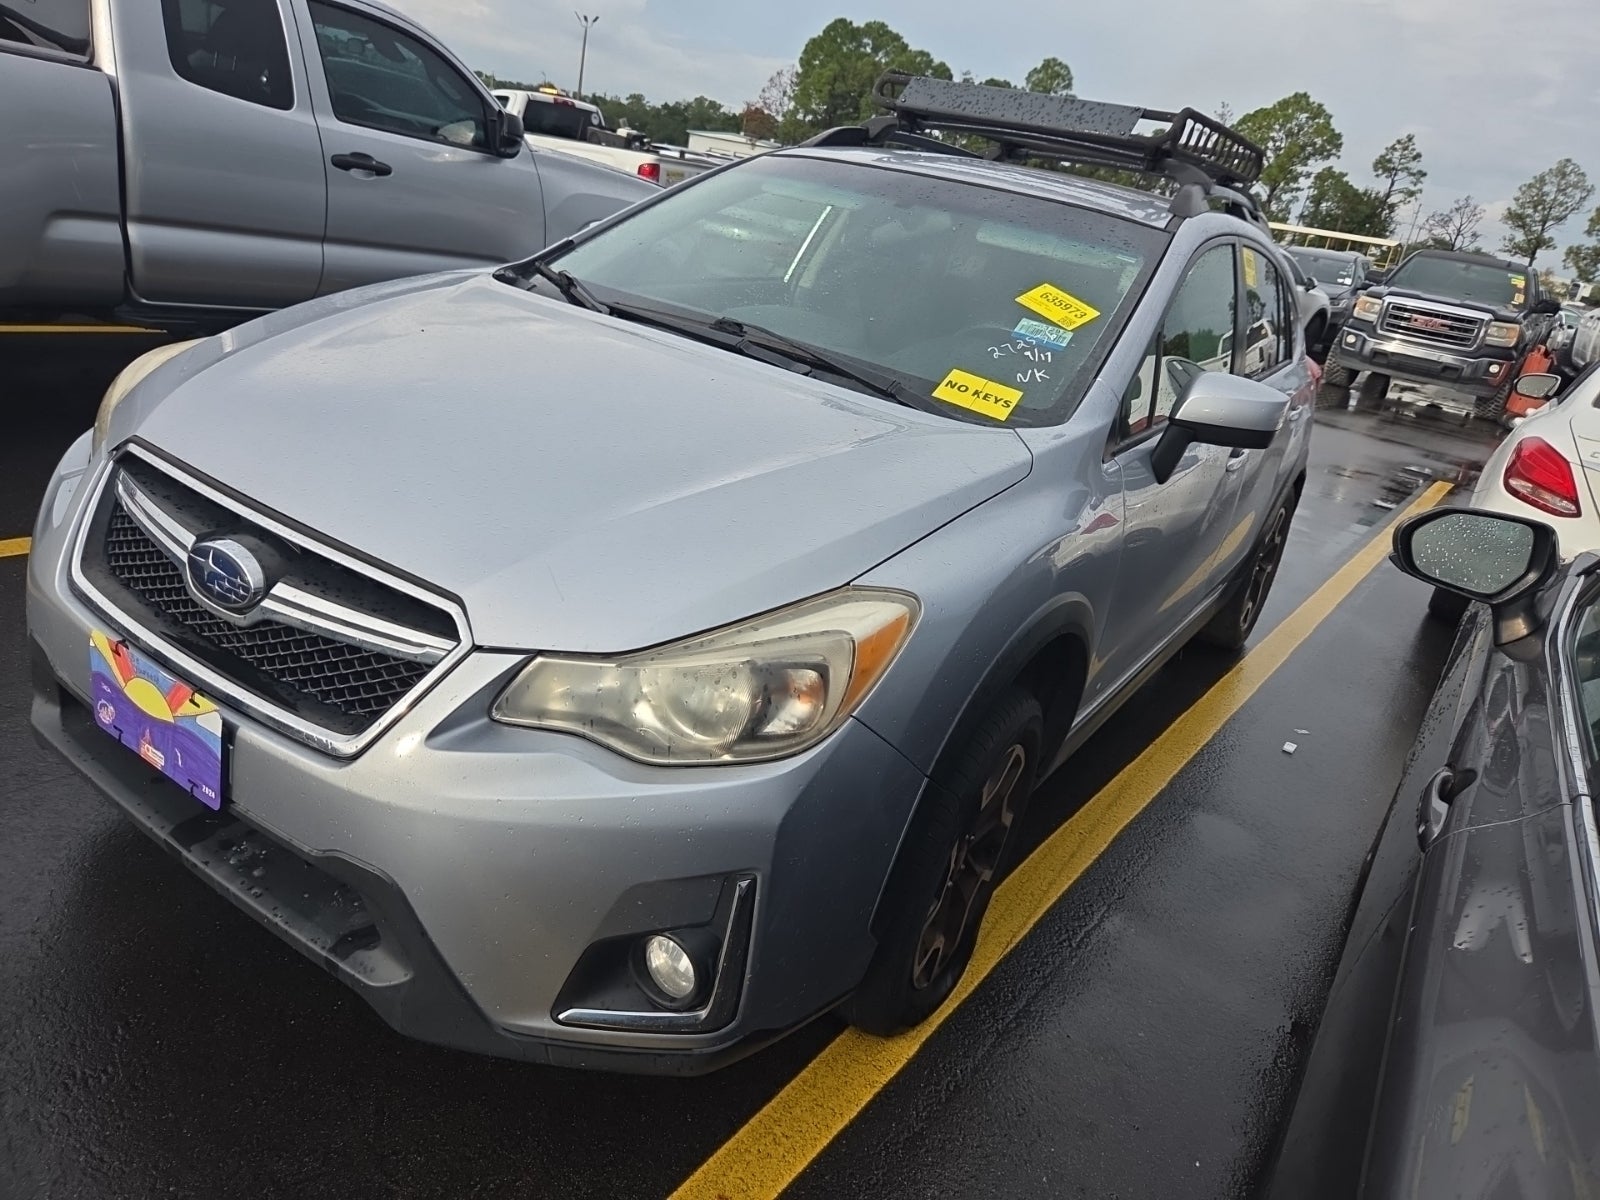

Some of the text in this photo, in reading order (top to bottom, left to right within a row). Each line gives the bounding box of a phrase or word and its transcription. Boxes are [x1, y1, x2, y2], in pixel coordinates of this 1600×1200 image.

[1039, 292, 1087, 319] 635973
[944, 379, 1013, 409] NO KEYS
